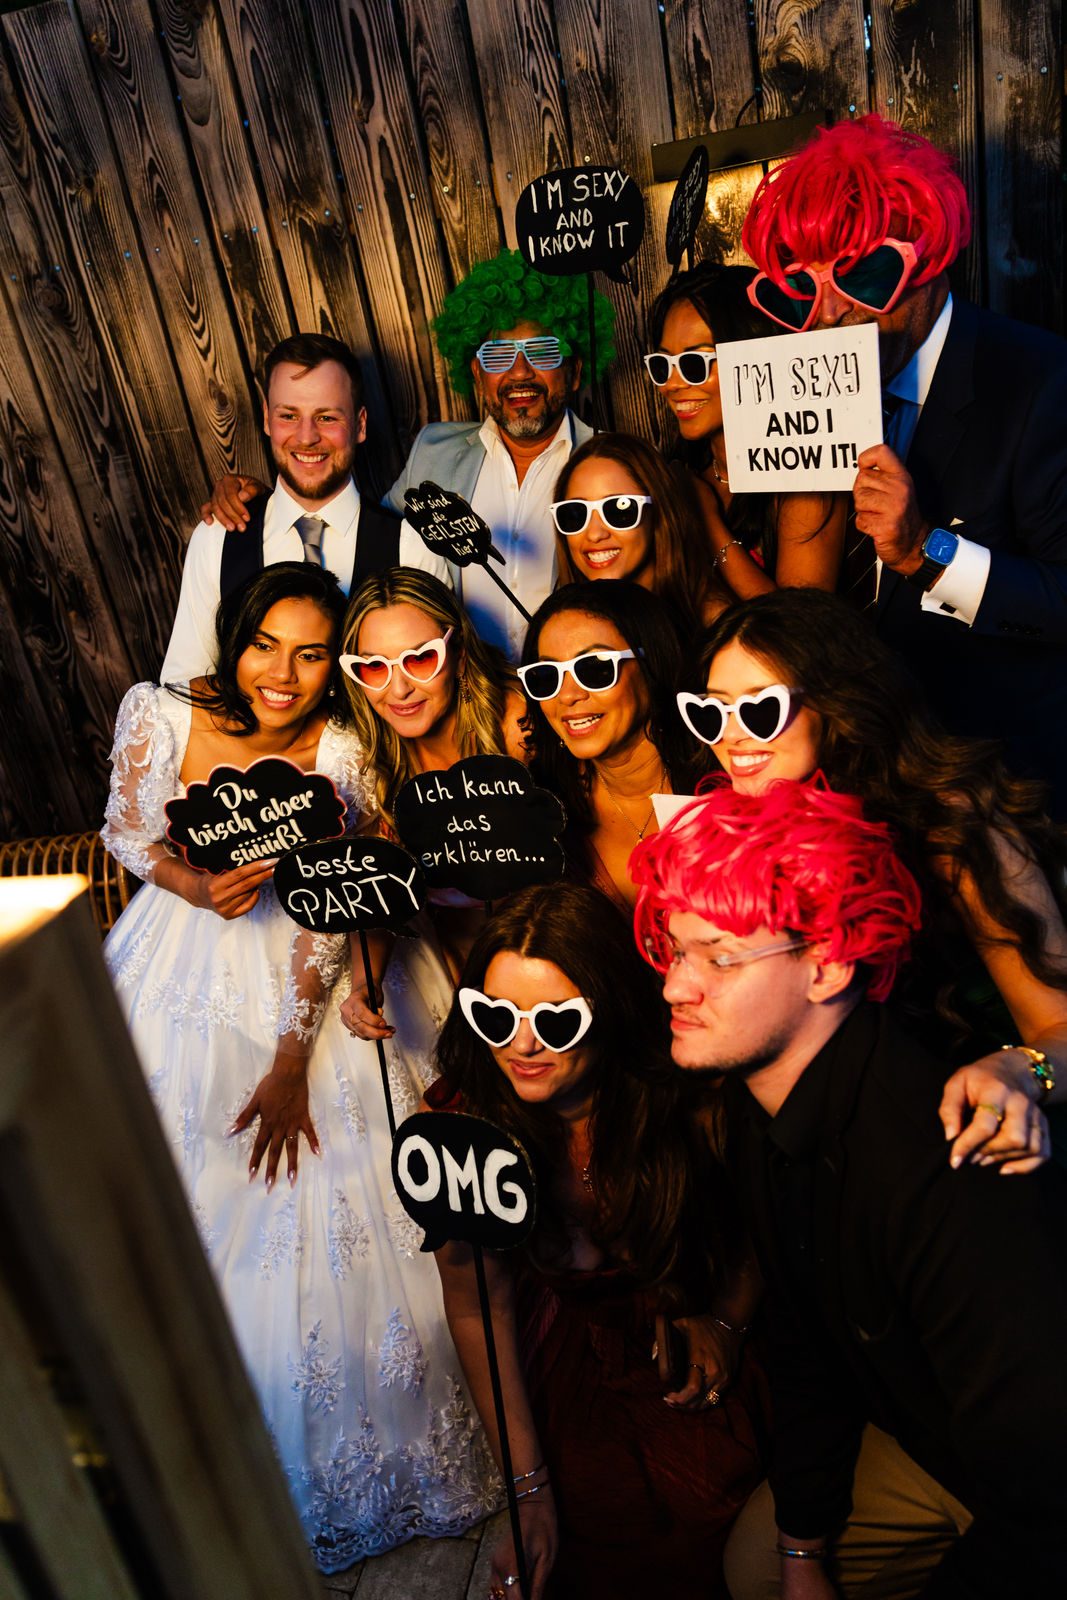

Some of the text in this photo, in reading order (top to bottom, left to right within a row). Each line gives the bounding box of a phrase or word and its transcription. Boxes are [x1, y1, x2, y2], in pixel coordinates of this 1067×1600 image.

[529, 170, 629, 213] I'M SEXY
[556, 208, 593, 230] AND
[529, 222, 629, 262] I KNOW IT
[733, 352, 860, 406] I'M SEXY
[766, 408, 833, 437] AND I
[748, 443, 858, 471] KNOW IT!
[405, 497, 425, 513] Wir
[420, 515, 480, 541] GEILSTEN
[213, 782, 259, 810] Du
[415, 770, 524, 804] Ich kann
[188, 790, 314, 846] bisch aber
[447, 814, 491, 833] das
[296, 846, 378, 878] beste
[288, 867, 419, 926] PARTY
[398, 1134, 528, 1224] OMG
